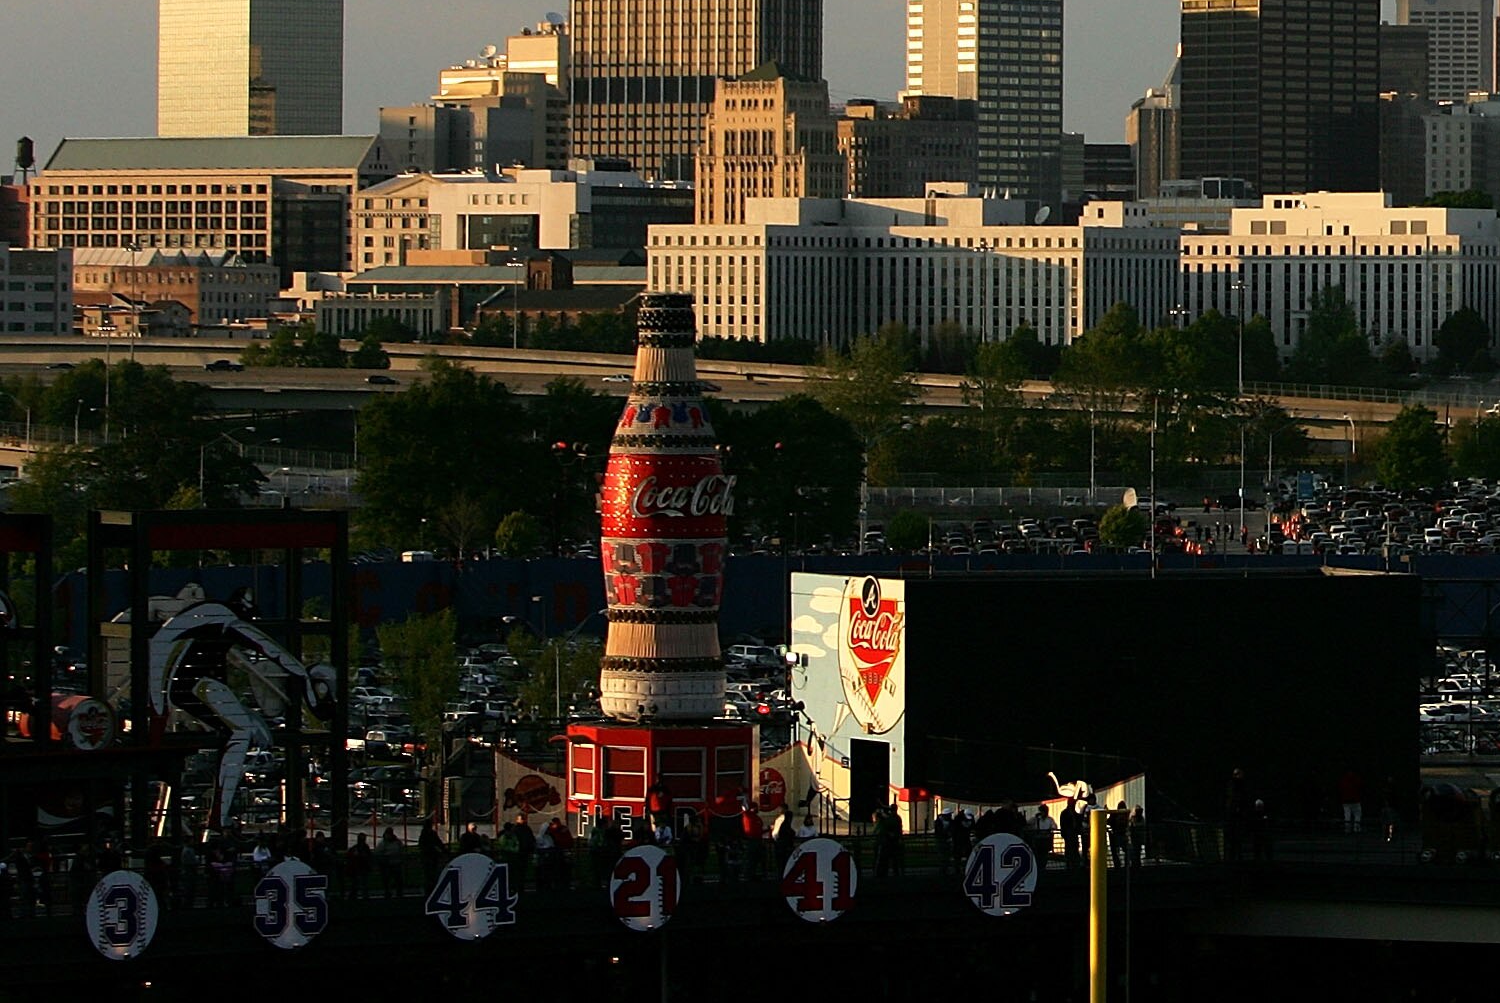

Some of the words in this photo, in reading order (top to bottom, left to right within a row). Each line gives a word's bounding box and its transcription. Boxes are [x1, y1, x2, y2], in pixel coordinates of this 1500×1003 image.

[631, 474, 738, 518] Coca-Cola
[863, 583, 878, 609] A
[847, 610, 900, 652] Coca-Cola
[253, 875, 328, 938] 35
[424, 863, 518, 928] 44
[612, 855, 679, 917] 21
[780, 851, 856, 912] 41
[963, 842, 1034, 909] 42
[104, 885, 139, 947] 3
